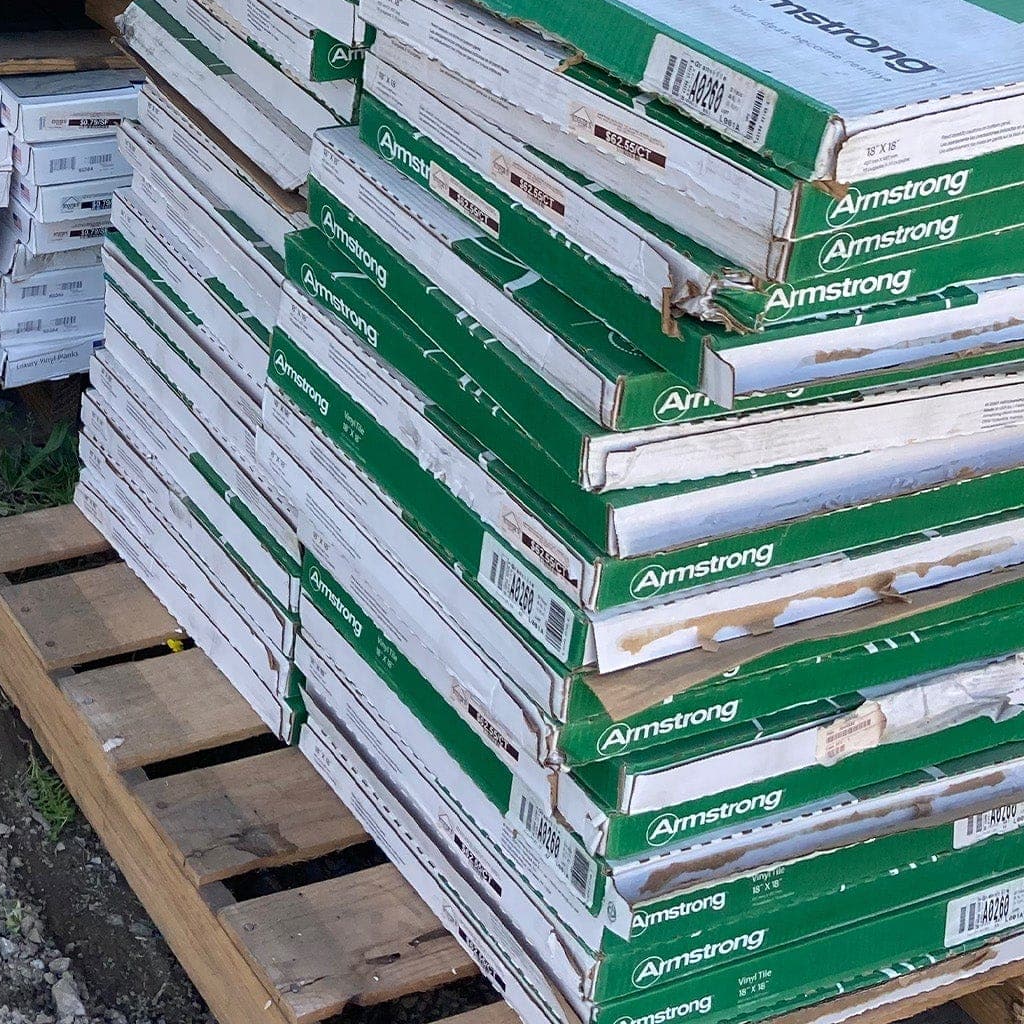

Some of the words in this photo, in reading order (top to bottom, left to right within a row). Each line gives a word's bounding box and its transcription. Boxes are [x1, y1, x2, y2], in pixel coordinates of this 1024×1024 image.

[689, 71, 725, 114] A0260
[867, 145, 880, 157] 18"
[879, 143, 887, 154] X
[888, 139, 901, 151] 18"
[831, 172, 969, 218] Armstrong
[322, 210, 387, 289] Armstrong
[824, 215, 960, 263] Armstrong
[303, 268, 378, 348] Armstrong
[764, 268, 912, 310] Armstrong
[16, 361, 38, 370] Luxury
[39, 356, 57, 365] Vinyl
[57, 351, 79, 362] Planks
[275, 353, 329, 415] Armstrong
[633, 542, 774, 594] Armstrong
[310, 570, 363, 637] Armstrong
[601, 699, 740, 749] Armstrong
[651, 789, 783, 840] Armstrong
[752, 870, 772, 883] Vinyl
[752, 883, 764, 895] 18"
[764, 881, 771, 891] X
[771, 877, 783, 889] 18"
[632, 891, 726, 929] Armstrong
[982, 894, 1010, 923] A0260
[636, 928, 765, 983] Armstrong
[738, 973, 757, 987] Vinyl
[758, 969, 773, 981] Tile
[738, 986, 751, 997] 18"
[750, 984, 756, 993] X
[756, 980, 770, 991] 18"
